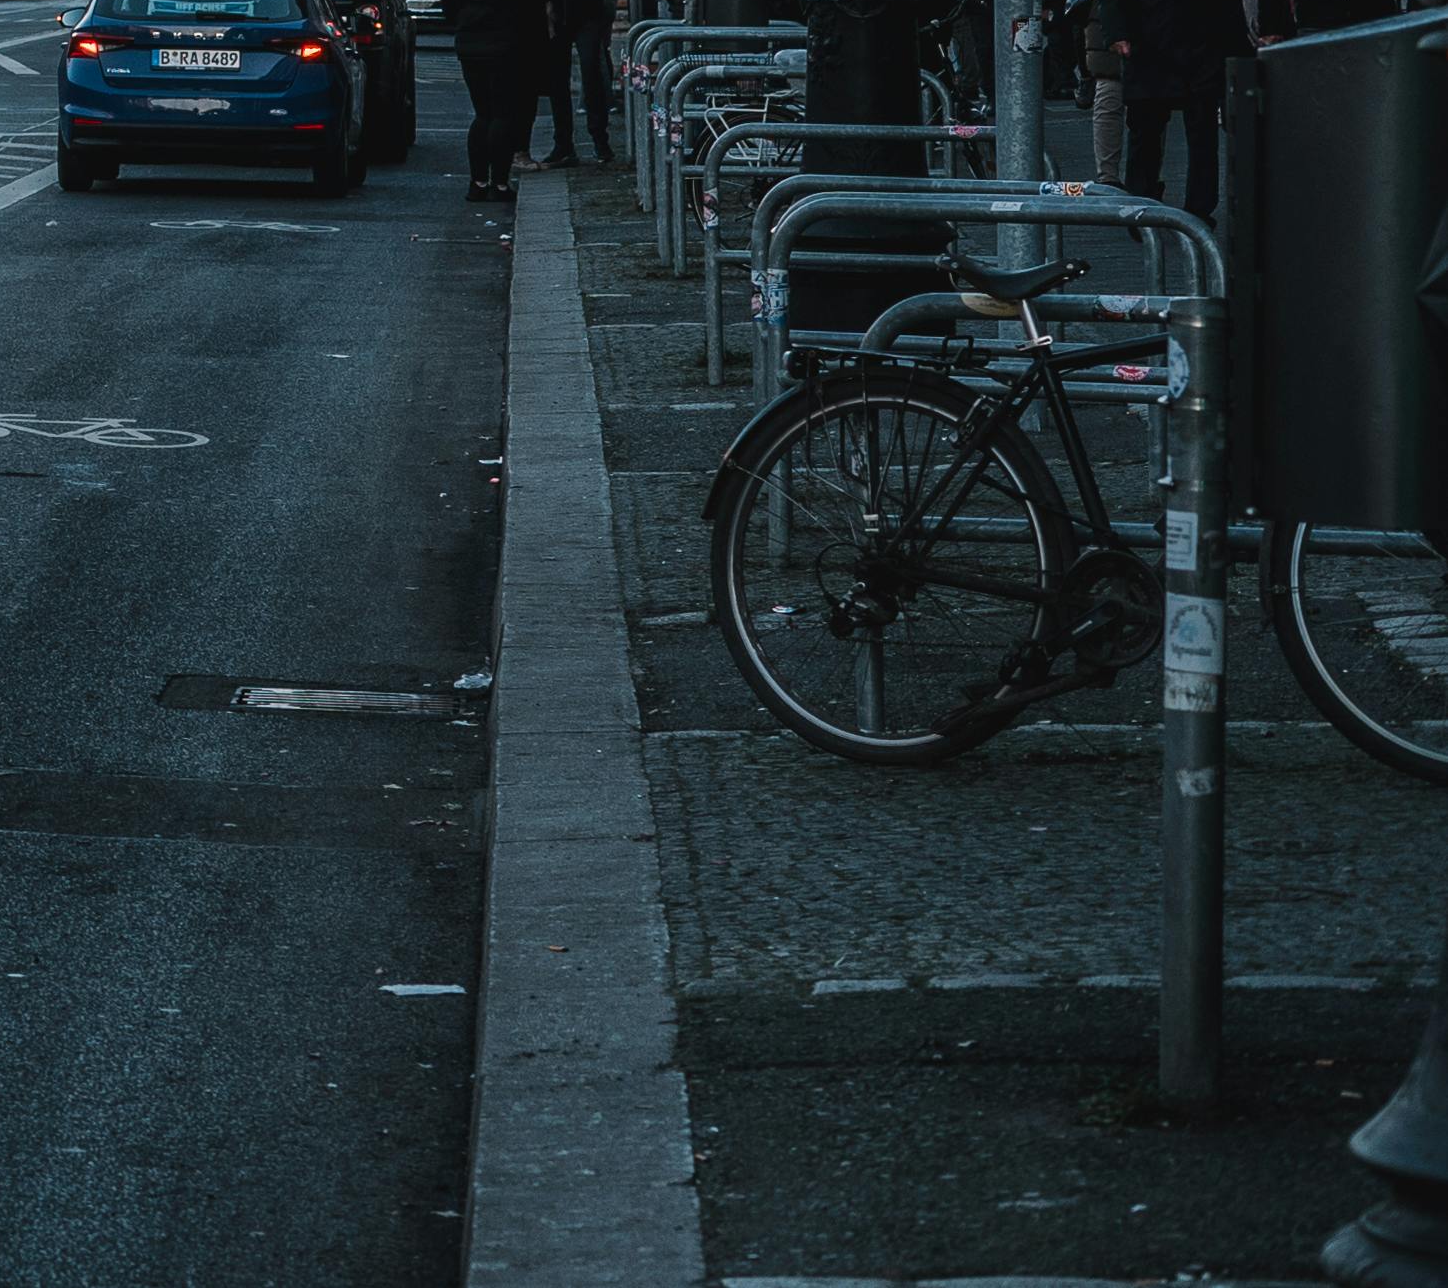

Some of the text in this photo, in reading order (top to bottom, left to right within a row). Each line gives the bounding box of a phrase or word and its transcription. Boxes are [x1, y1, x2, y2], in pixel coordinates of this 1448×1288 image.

[161, 51, 238, 66] B RA 8489
